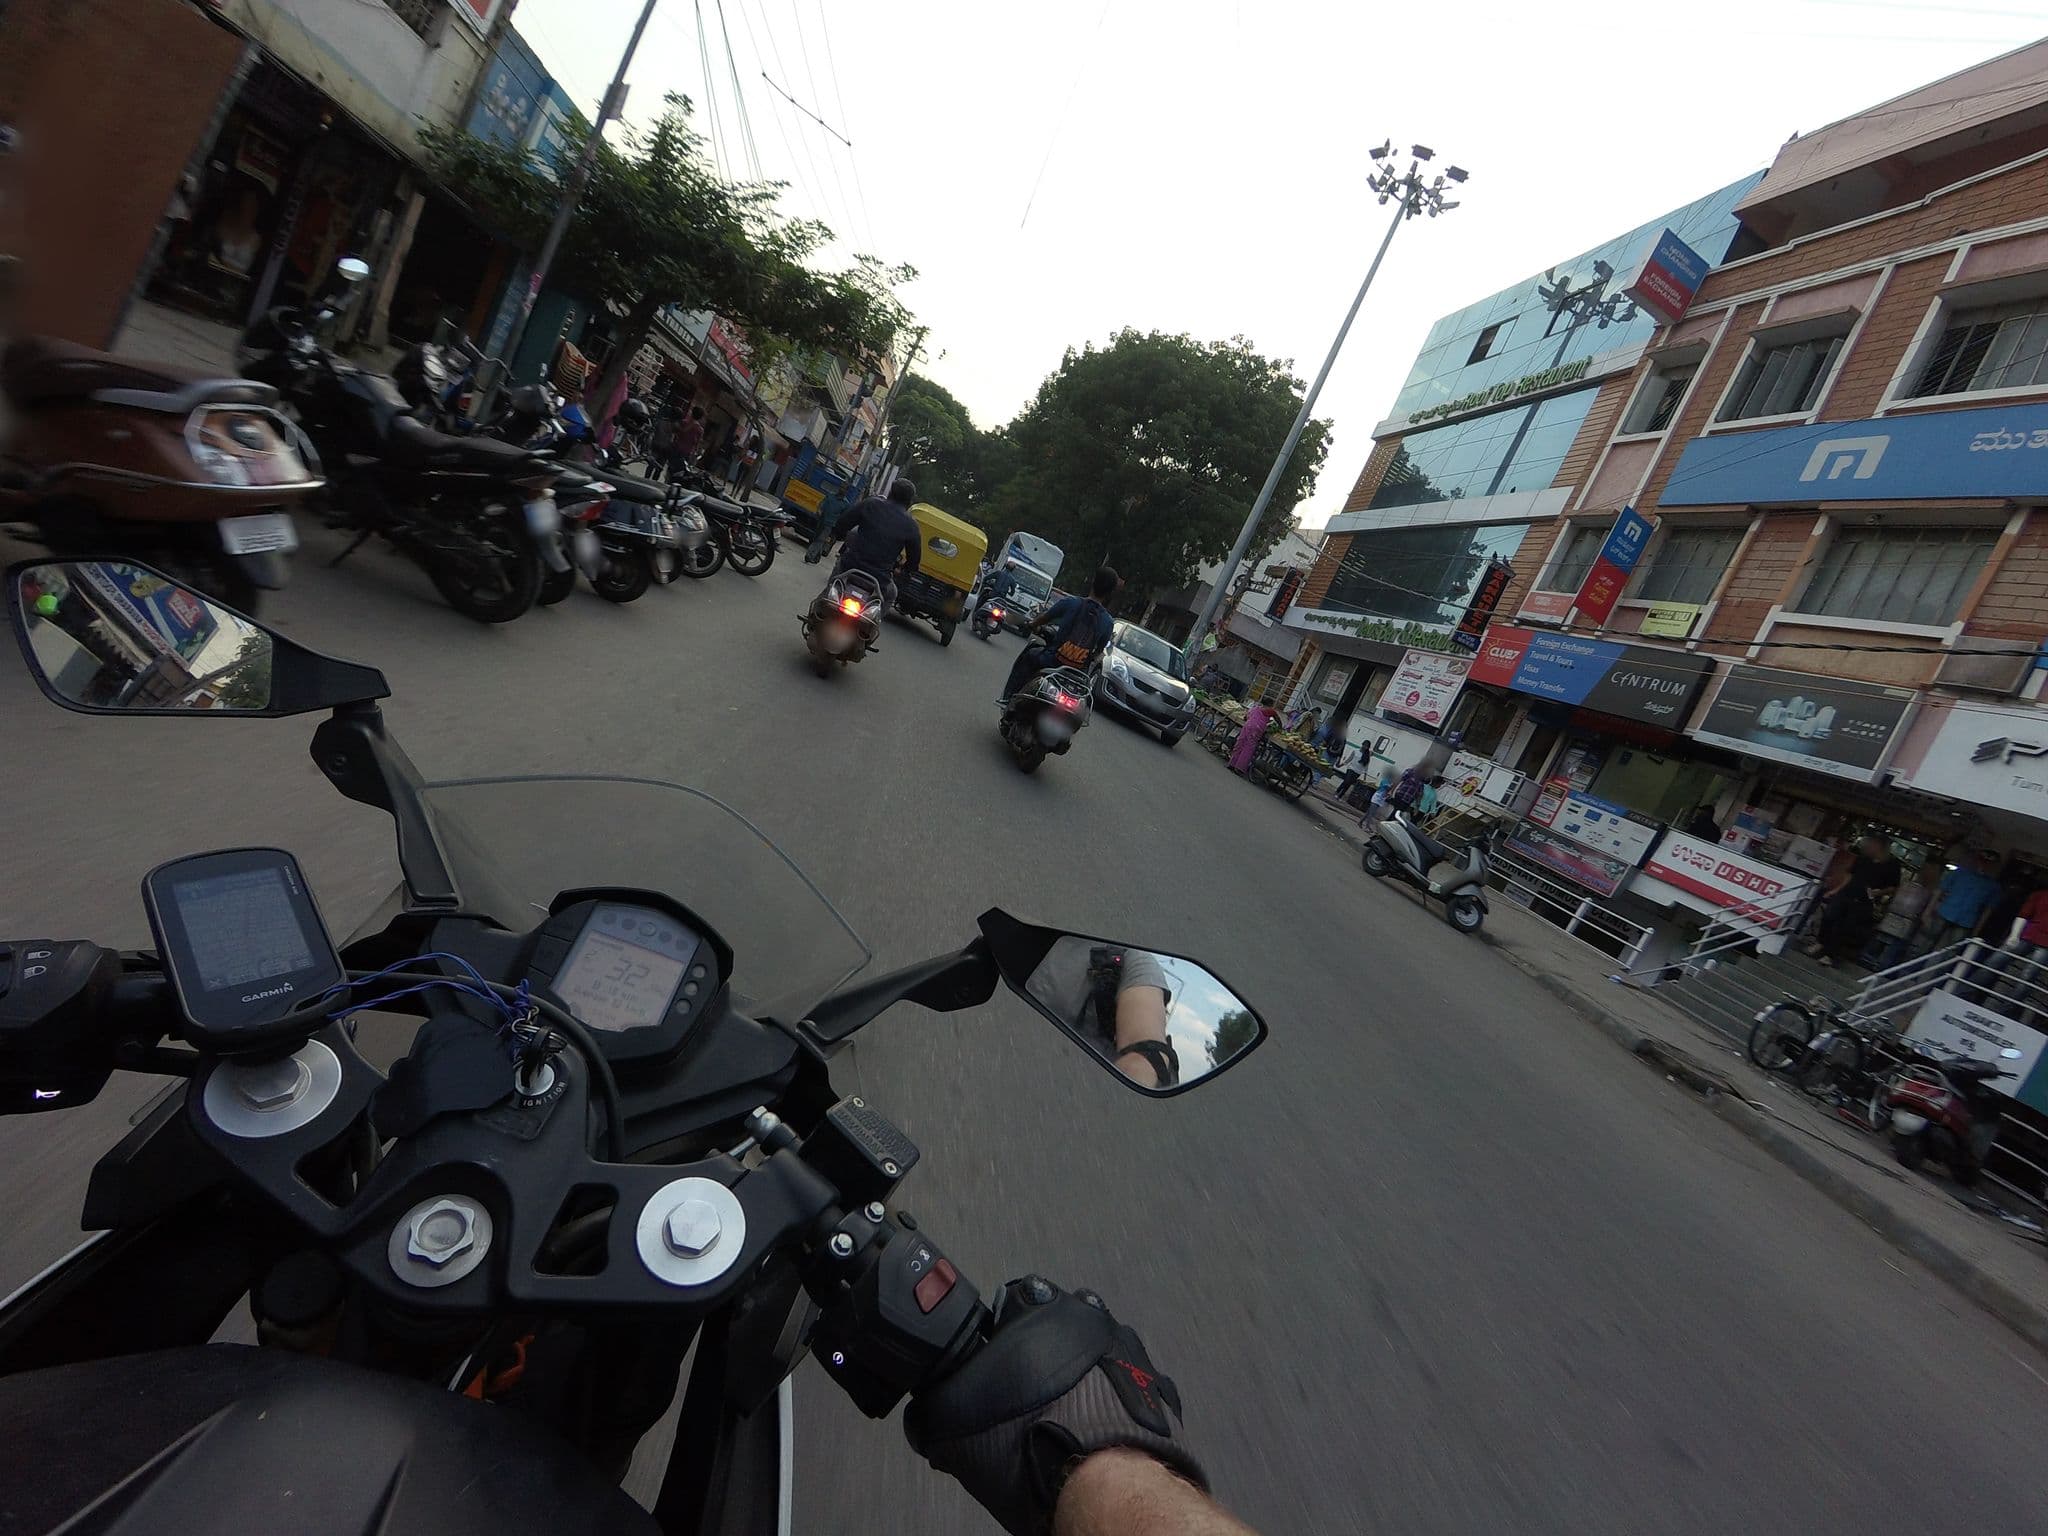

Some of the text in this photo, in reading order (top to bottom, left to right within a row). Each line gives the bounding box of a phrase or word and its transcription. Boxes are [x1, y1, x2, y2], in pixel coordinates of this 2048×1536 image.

[1513, 355, 1592, 394] Restaurant
[1534, 636, 1596, 656] Foreign Exchange
[1523, 662, 1540, 674] Visas
[1529, 650, 1549, 662] Travel
[1556, 655, 1574, 667] Tours
[1517, 675, 1567, 695] Money Transfer
[1716, 862, 1780, 898] USHA
[604, 956, 651, 988] 32
[240, 982, 296, 1004] GARMIN
[522, 1081, 568, 1108] IGNITION
